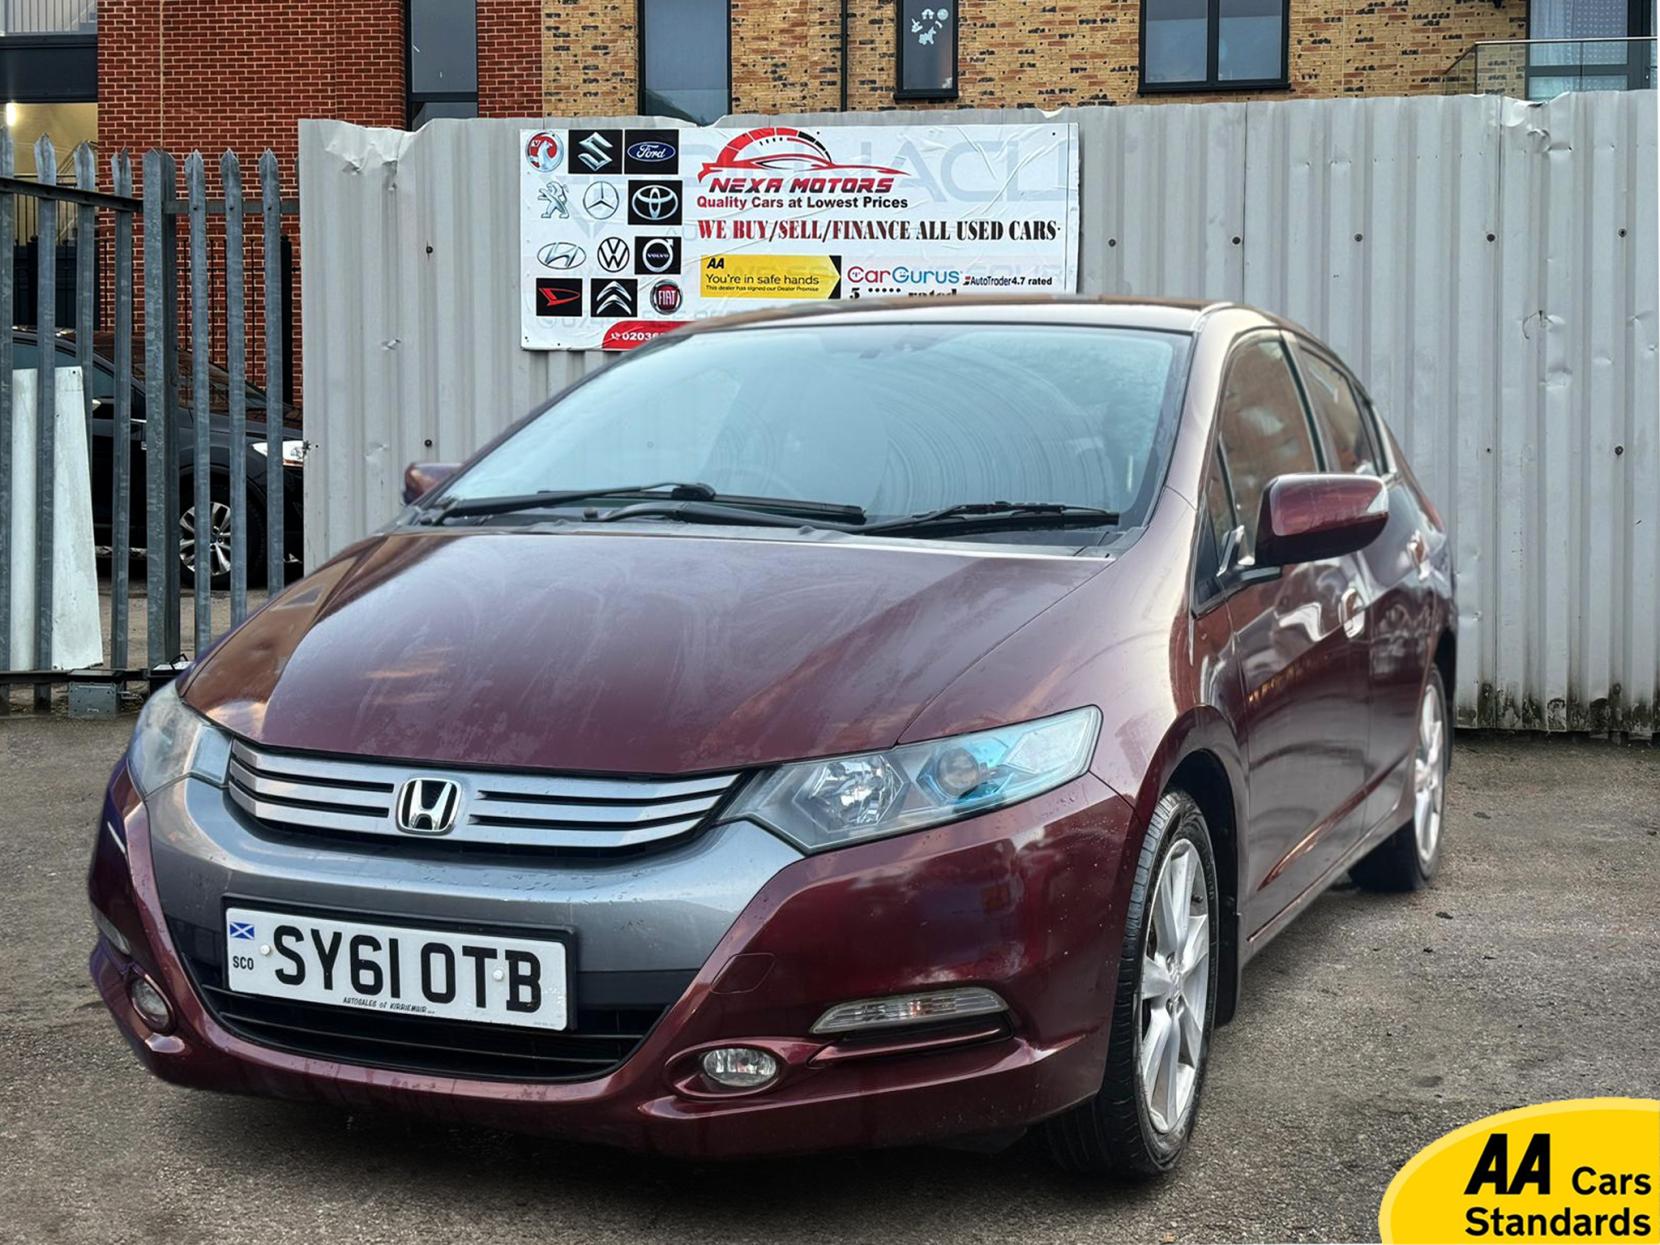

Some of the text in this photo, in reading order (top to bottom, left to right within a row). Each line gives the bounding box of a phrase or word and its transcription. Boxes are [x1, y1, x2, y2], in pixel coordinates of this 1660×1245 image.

[636, 144, 666, 158] Ford
[708, 177, 895, 194] NEXA MOTORS
[697, 196, 908, 210] Quality Cars at Lowest Prices
[697, 220, 727, 240] WE
[733, 220, 910, 243] BUY/SELL/FINANCE
[916, 220, 950, 240] ALL
[956, 220, 1004, 240] USED
[1008, 220, 1057, 240] CARS
[706, 257, 725, 269] AA
[706, 274, 819, 285] You're in safe hands
[847, 266, 960, 284] CarGurus
[1028, 276, 1053, 286] rated
[658, 290, 676, 306] FIAT
[232, 955, 254, 971] SCO
[273, 925, 542, 1013] SY61 OTB
